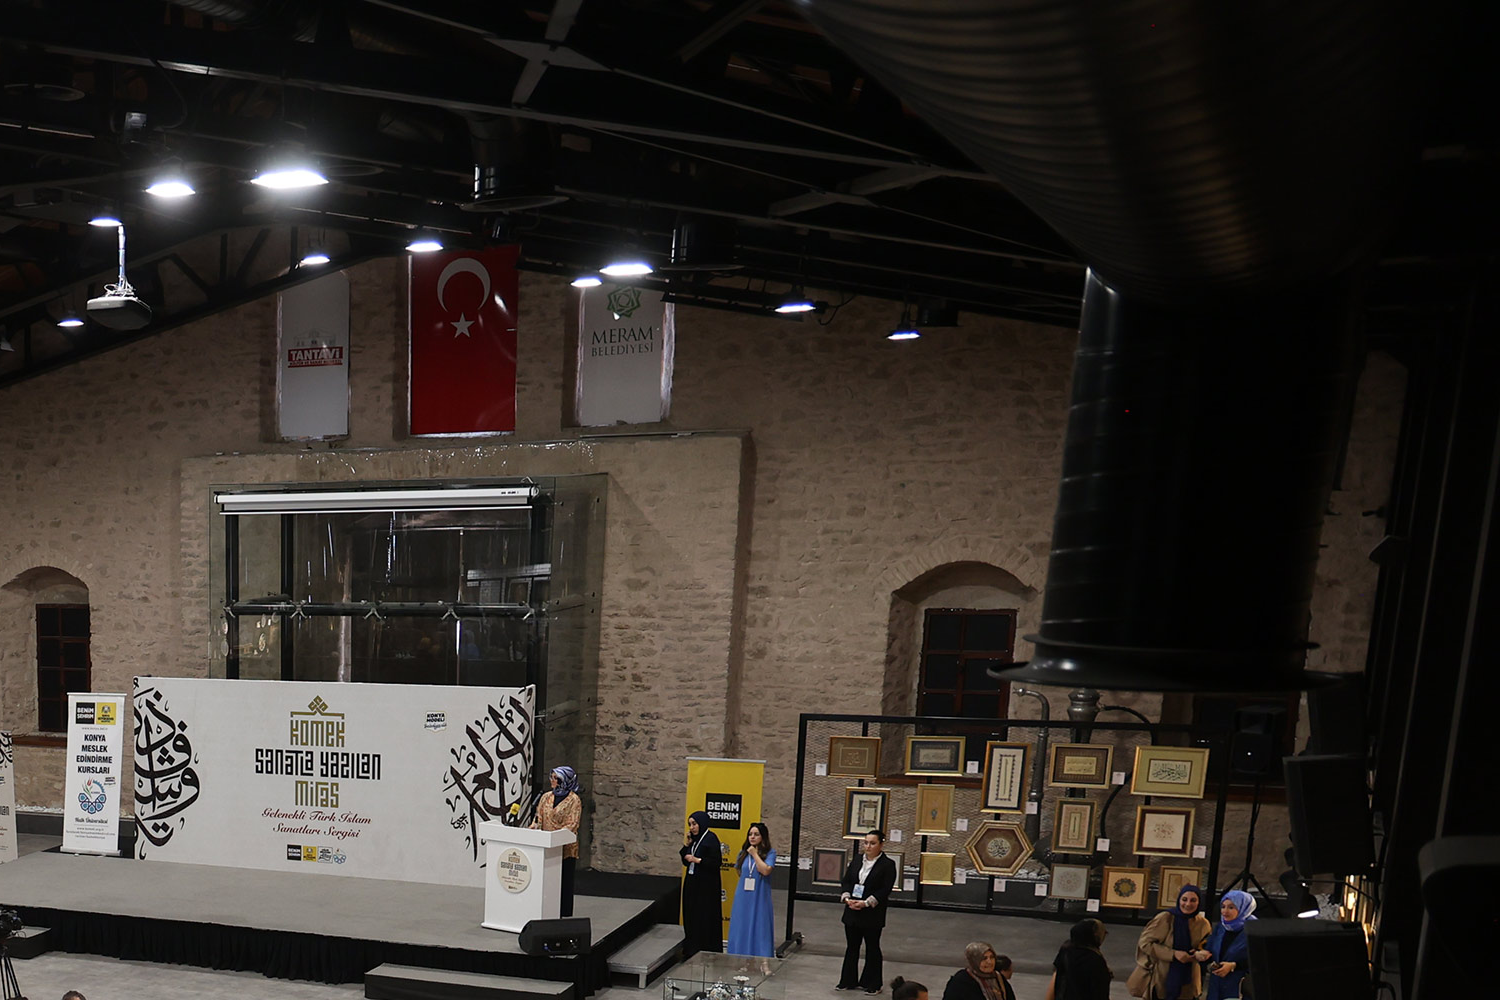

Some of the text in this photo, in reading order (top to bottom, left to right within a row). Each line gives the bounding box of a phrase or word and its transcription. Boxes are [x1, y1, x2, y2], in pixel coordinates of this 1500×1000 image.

[591, 326, 653, 345] MERAM
[84, 734, 106, 742] KONYA
[81, 745, 108, 753] MESLEK
[76, 754, 113, 764] EDİNDİRME
[77, 766, 110, 774] KURSLARI
[707, 801, 740, 812] BENİM
[262, 807, 372, 825] Gelenekli Türk İslam
[272, 822, 361, 840] Sanatları Sergisi
